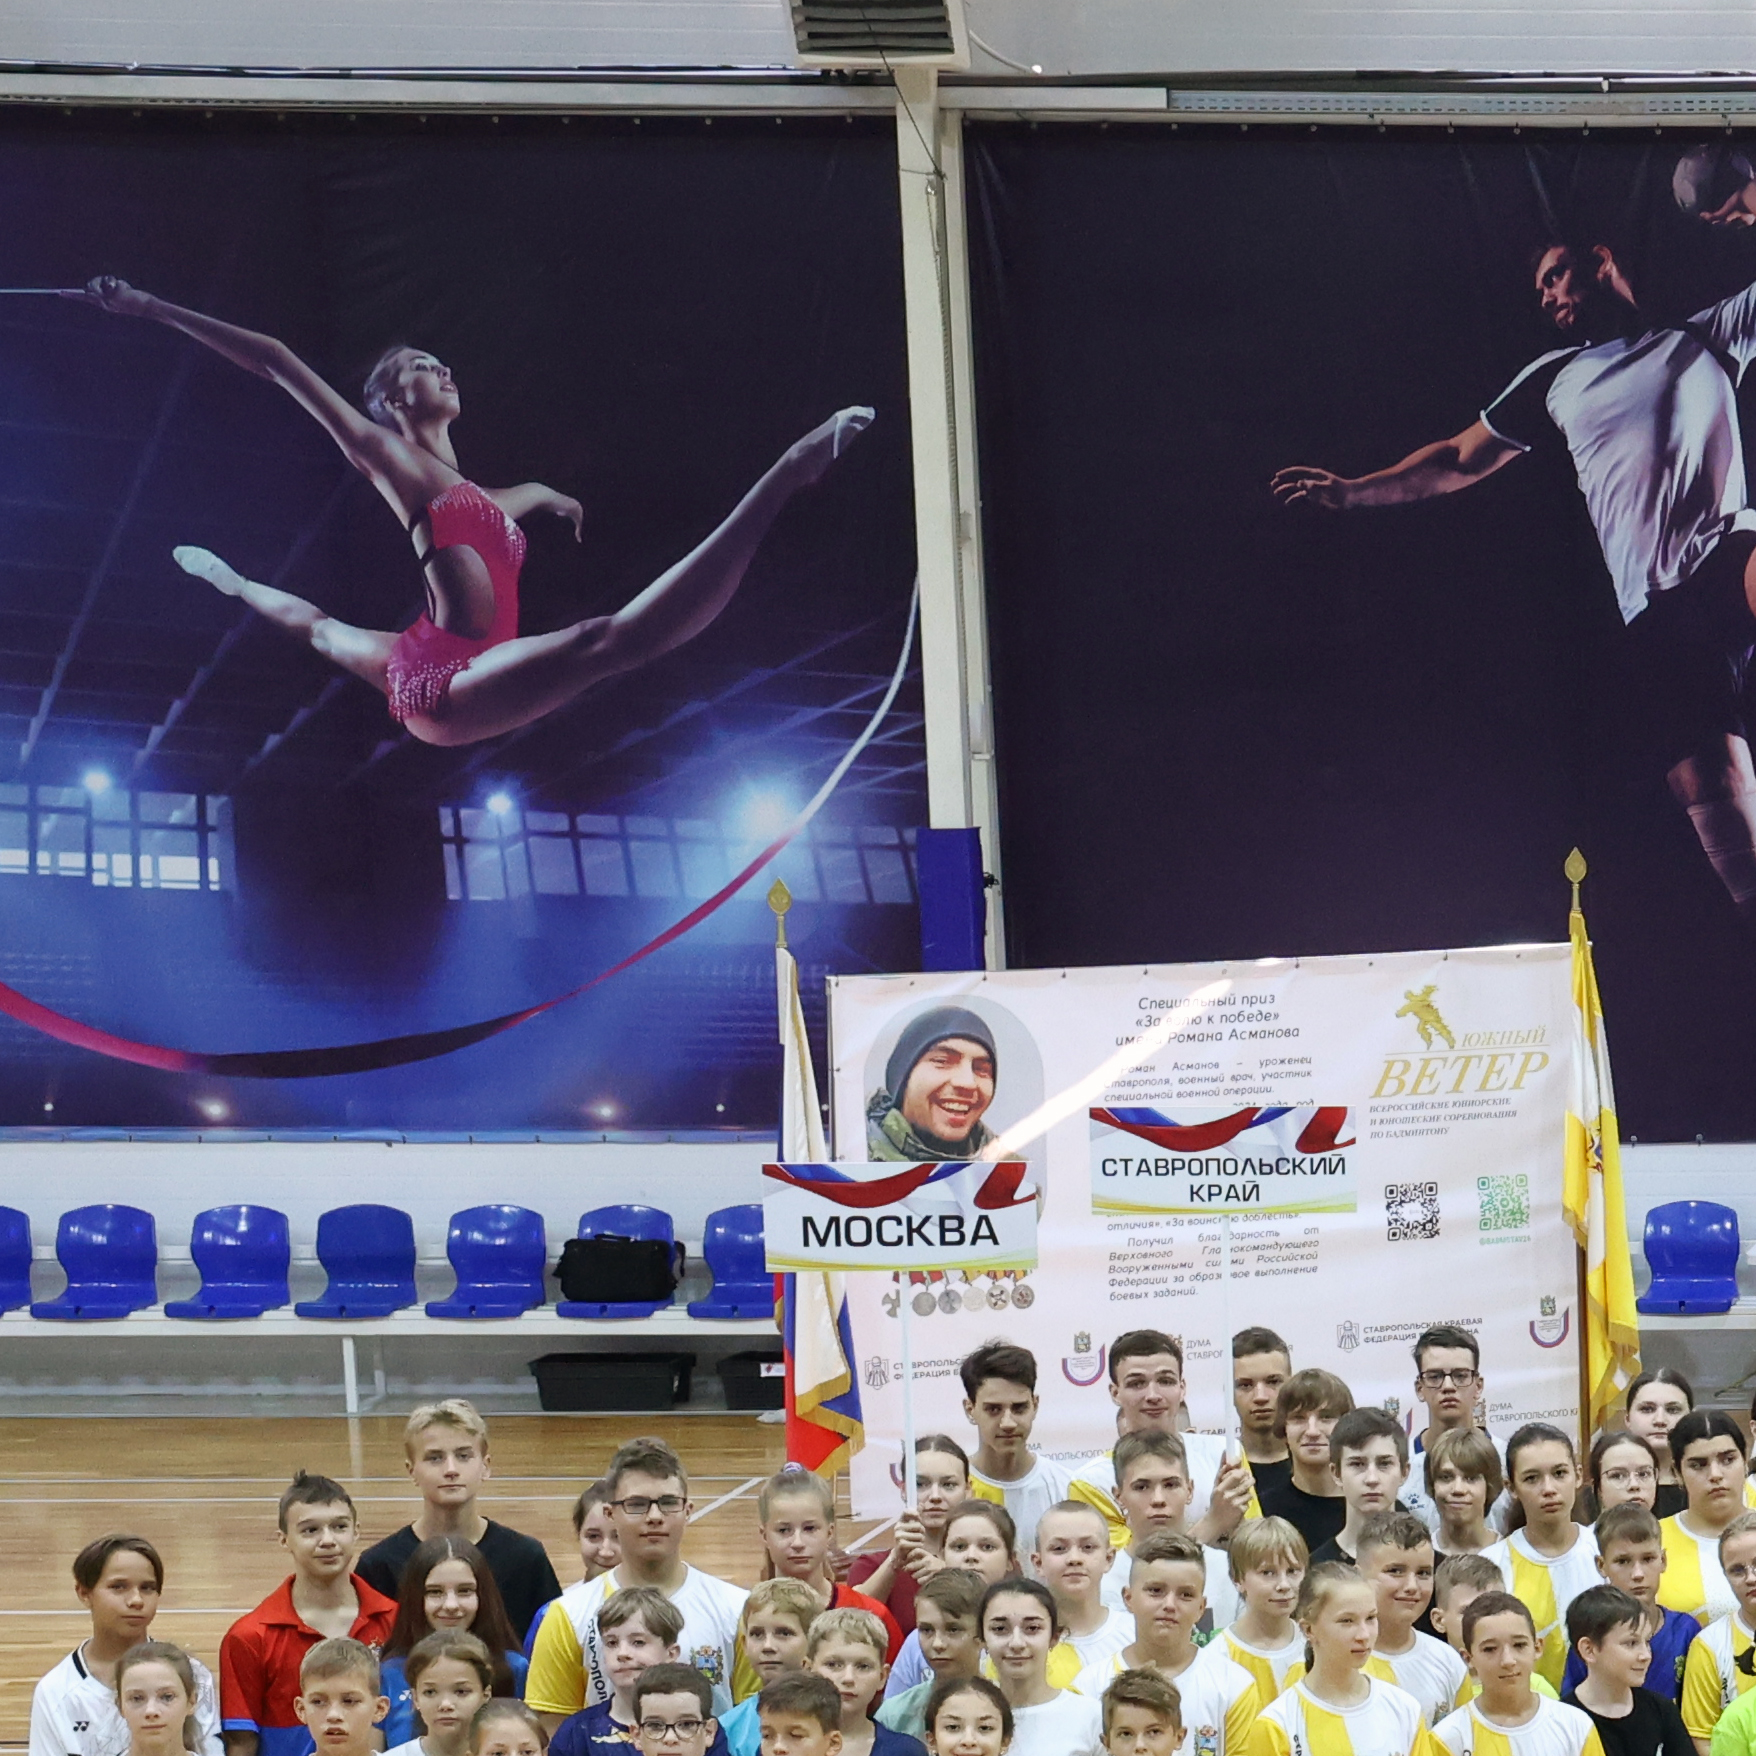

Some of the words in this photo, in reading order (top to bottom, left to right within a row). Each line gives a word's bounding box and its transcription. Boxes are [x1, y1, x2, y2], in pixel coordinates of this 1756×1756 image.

[1138, 993, 1237, 1011] Специальный
[1241, 994, 1276, 1008] приз
[1135, 1014, 1162, 1028] «За
[1207, 1015, 1214, 1024] к
[1220, 1010, 1280, 1023] победе»
[1167, 1030, 1224, 1044] Романа
[1228, 1027, 1300, 1041] Асманова
[1461, 1024, 1547, 1049] ЮЖНЫЙ
[1172, 1061, 1220, 1071] Асманов
[1259, 1056, 1312, 1069] уроженец
[1178, 1073, 1225, 1085] военный
[1230, 1072, 1256, 1083] врач,
[1261, 1069, 1313, 1081] участник
[1368, 1051, 1551, 1099] ВЕТЕР
[1104, 1090, 1173, 1102] специальной
[1176, 1086, 1221, 1098] военной
[1223, 1085, 1275, 1097] операции.
[1369, 1101, 1450, 1113] ВСЕРОССИЙСКИЕ
[1451, 1098, 1512, 1109] ЮНИОРСКИЕ
[1370, 1118, 1377, 1126] И
[1379, 1114, 1442, 1126] ЮНОШЕСКИЕ
[1444, 1110, 1518, 1122] СОРЕВНОВАНИЯ
[1370, 1131, 1384, 1139] ПО
[1386, 1127, 1450, 1138] БАДМИНТОНУ
[1101, 1155, 1347, 1179] СТАВРОПОЛЬСКИЙ
[1189, 1179, 1260, 1203] КРАЙ
[1165, 1217, 1184, 1228] «За
[801, 1214, 1000, 1248] МОСКВА
[1127, 1236, 1174, 1247] Получил
[1303, 1227, 1320, 1235] от
[1108, 1261, 1194, 1274] Вооруженными
[1205, 1257, 1245, 1268] сими
[1256, 1252, 1318, 1264] Российской
[1109, 1250, 1174, 1262] Верховного
[1108, 1275, 1168, 1288] Федерации
[1172, 1274, 1184, 1283] за
[1254, 1265, 1318, 1278] выполнение
[1109, 1290, 1150, 1301] боевых
[1153, 1286, 1199, 1299] заданий.
[1187, 1339, 1211, 1350] ДУМА
[1363, 1332, 1417, 1344] ФЕДЕРАЦИЯ
[1489, 1402, 1513, 1412] ДУМА
[1489, 1409, 1564, 1423] СТАВРОПОЛЬСКОГО
